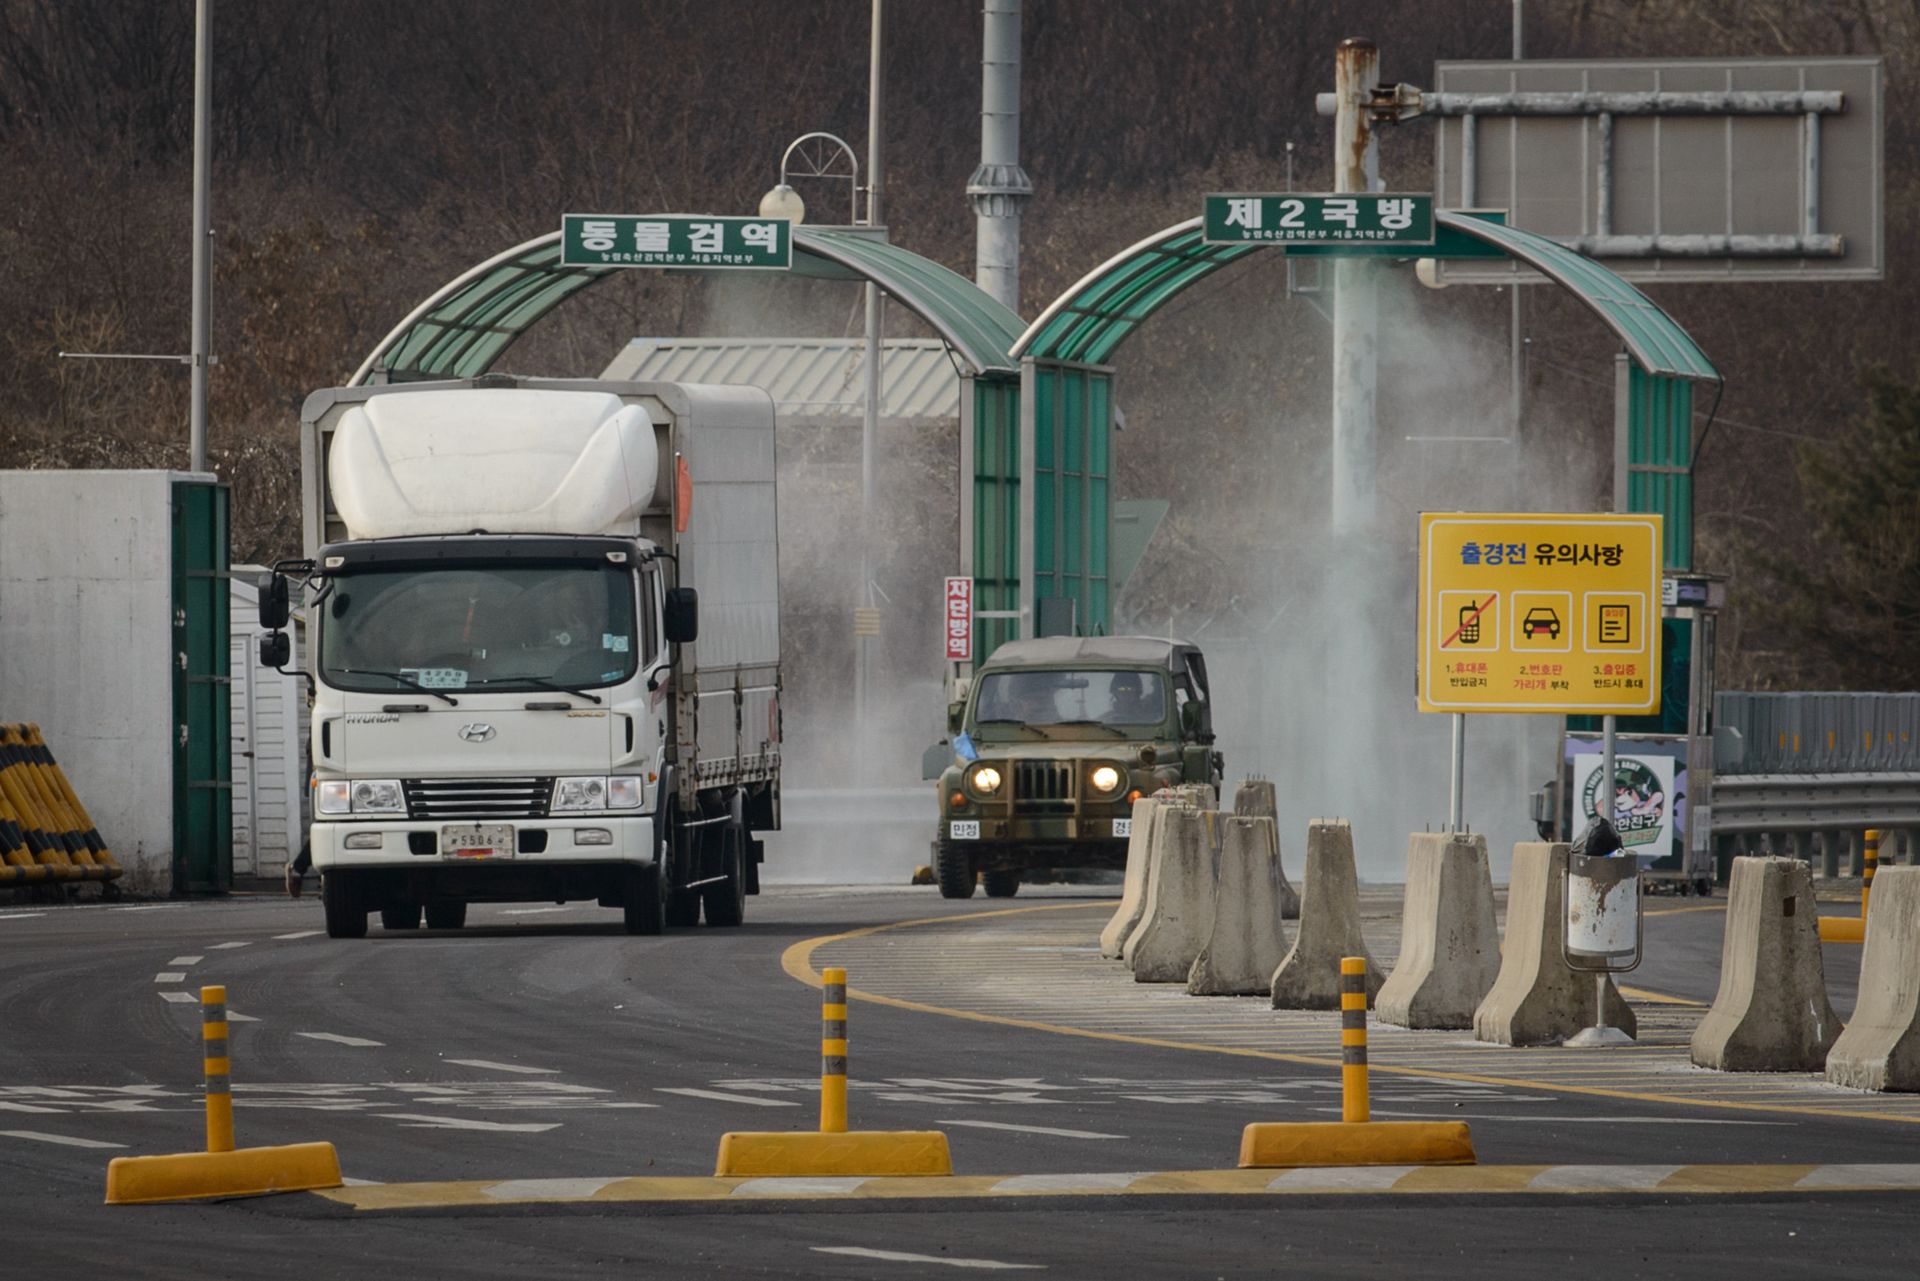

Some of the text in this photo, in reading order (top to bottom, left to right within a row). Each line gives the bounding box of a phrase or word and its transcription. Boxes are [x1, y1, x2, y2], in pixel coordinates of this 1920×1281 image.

[1224, 198, 1416, 230] 제2국방
[580, 220, 778, 254] 동물검역
[1460, 541, 1624, 566] 출경전 유의사항
[1115, 821, 1132, 837] 경
